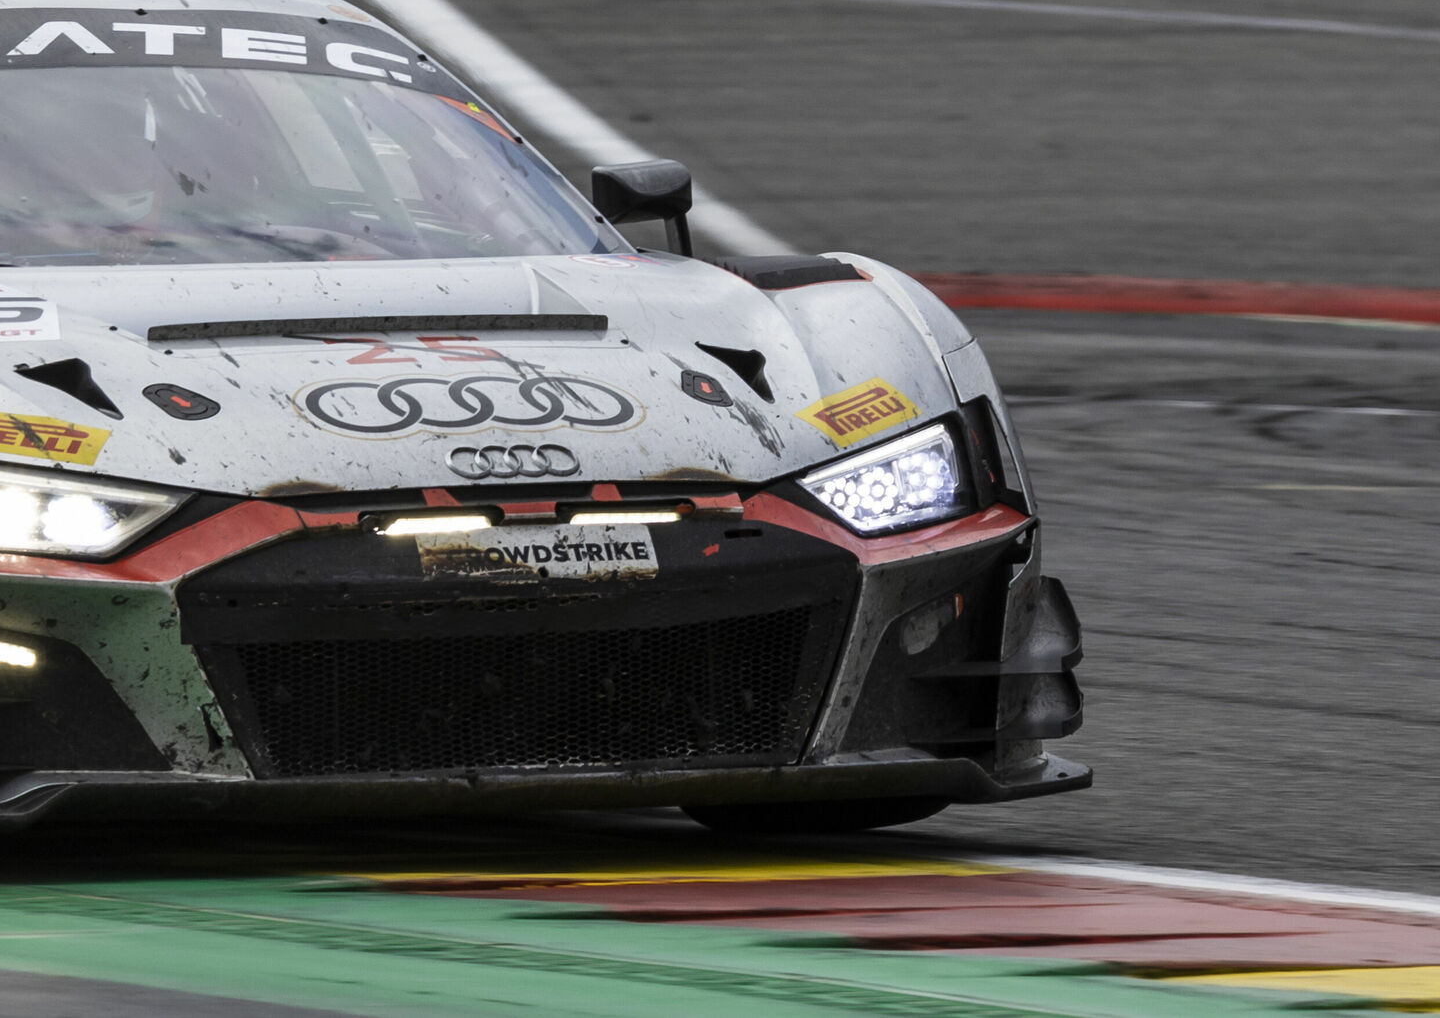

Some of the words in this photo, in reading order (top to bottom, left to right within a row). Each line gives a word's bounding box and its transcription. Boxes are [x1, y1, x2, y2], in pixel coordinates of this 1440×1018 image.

[324, 336, 503, 365] 25
[813, 386, 906, 436] PIRELLI
[442, 542, 650, 565] OWDSTRIKE
